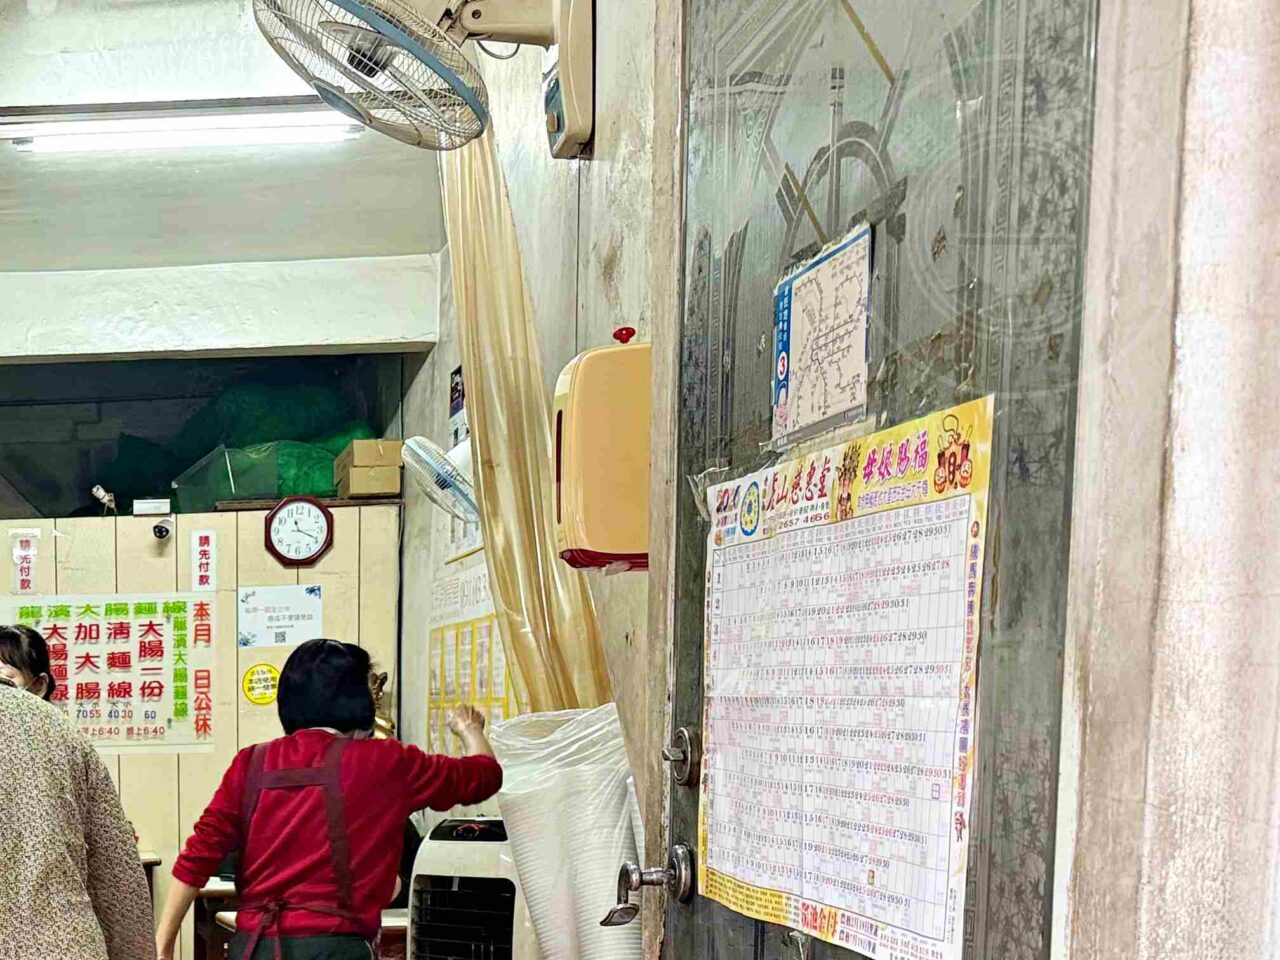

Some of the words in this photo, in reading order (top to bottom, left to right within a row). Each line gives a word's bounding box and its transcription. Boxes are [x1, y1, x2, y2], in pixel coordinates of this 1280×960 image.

[198, 535, 211, 586] 請先付款
[193, 601, 211, 645] 本月
[74, 623, 101, 700] 加大腸
[106, 622, 133, 699] 清麵線
[138, 620, 165, 699] 大腸一份
[76, 710, 87, 719] 70
[89, 710, 101, 719] 55
[107, 710, 119, 719] 40
[121, 710, 133, 719] 30
[144, 710, 156, 719] 60
[194, 669, 212, 736] 日公休
